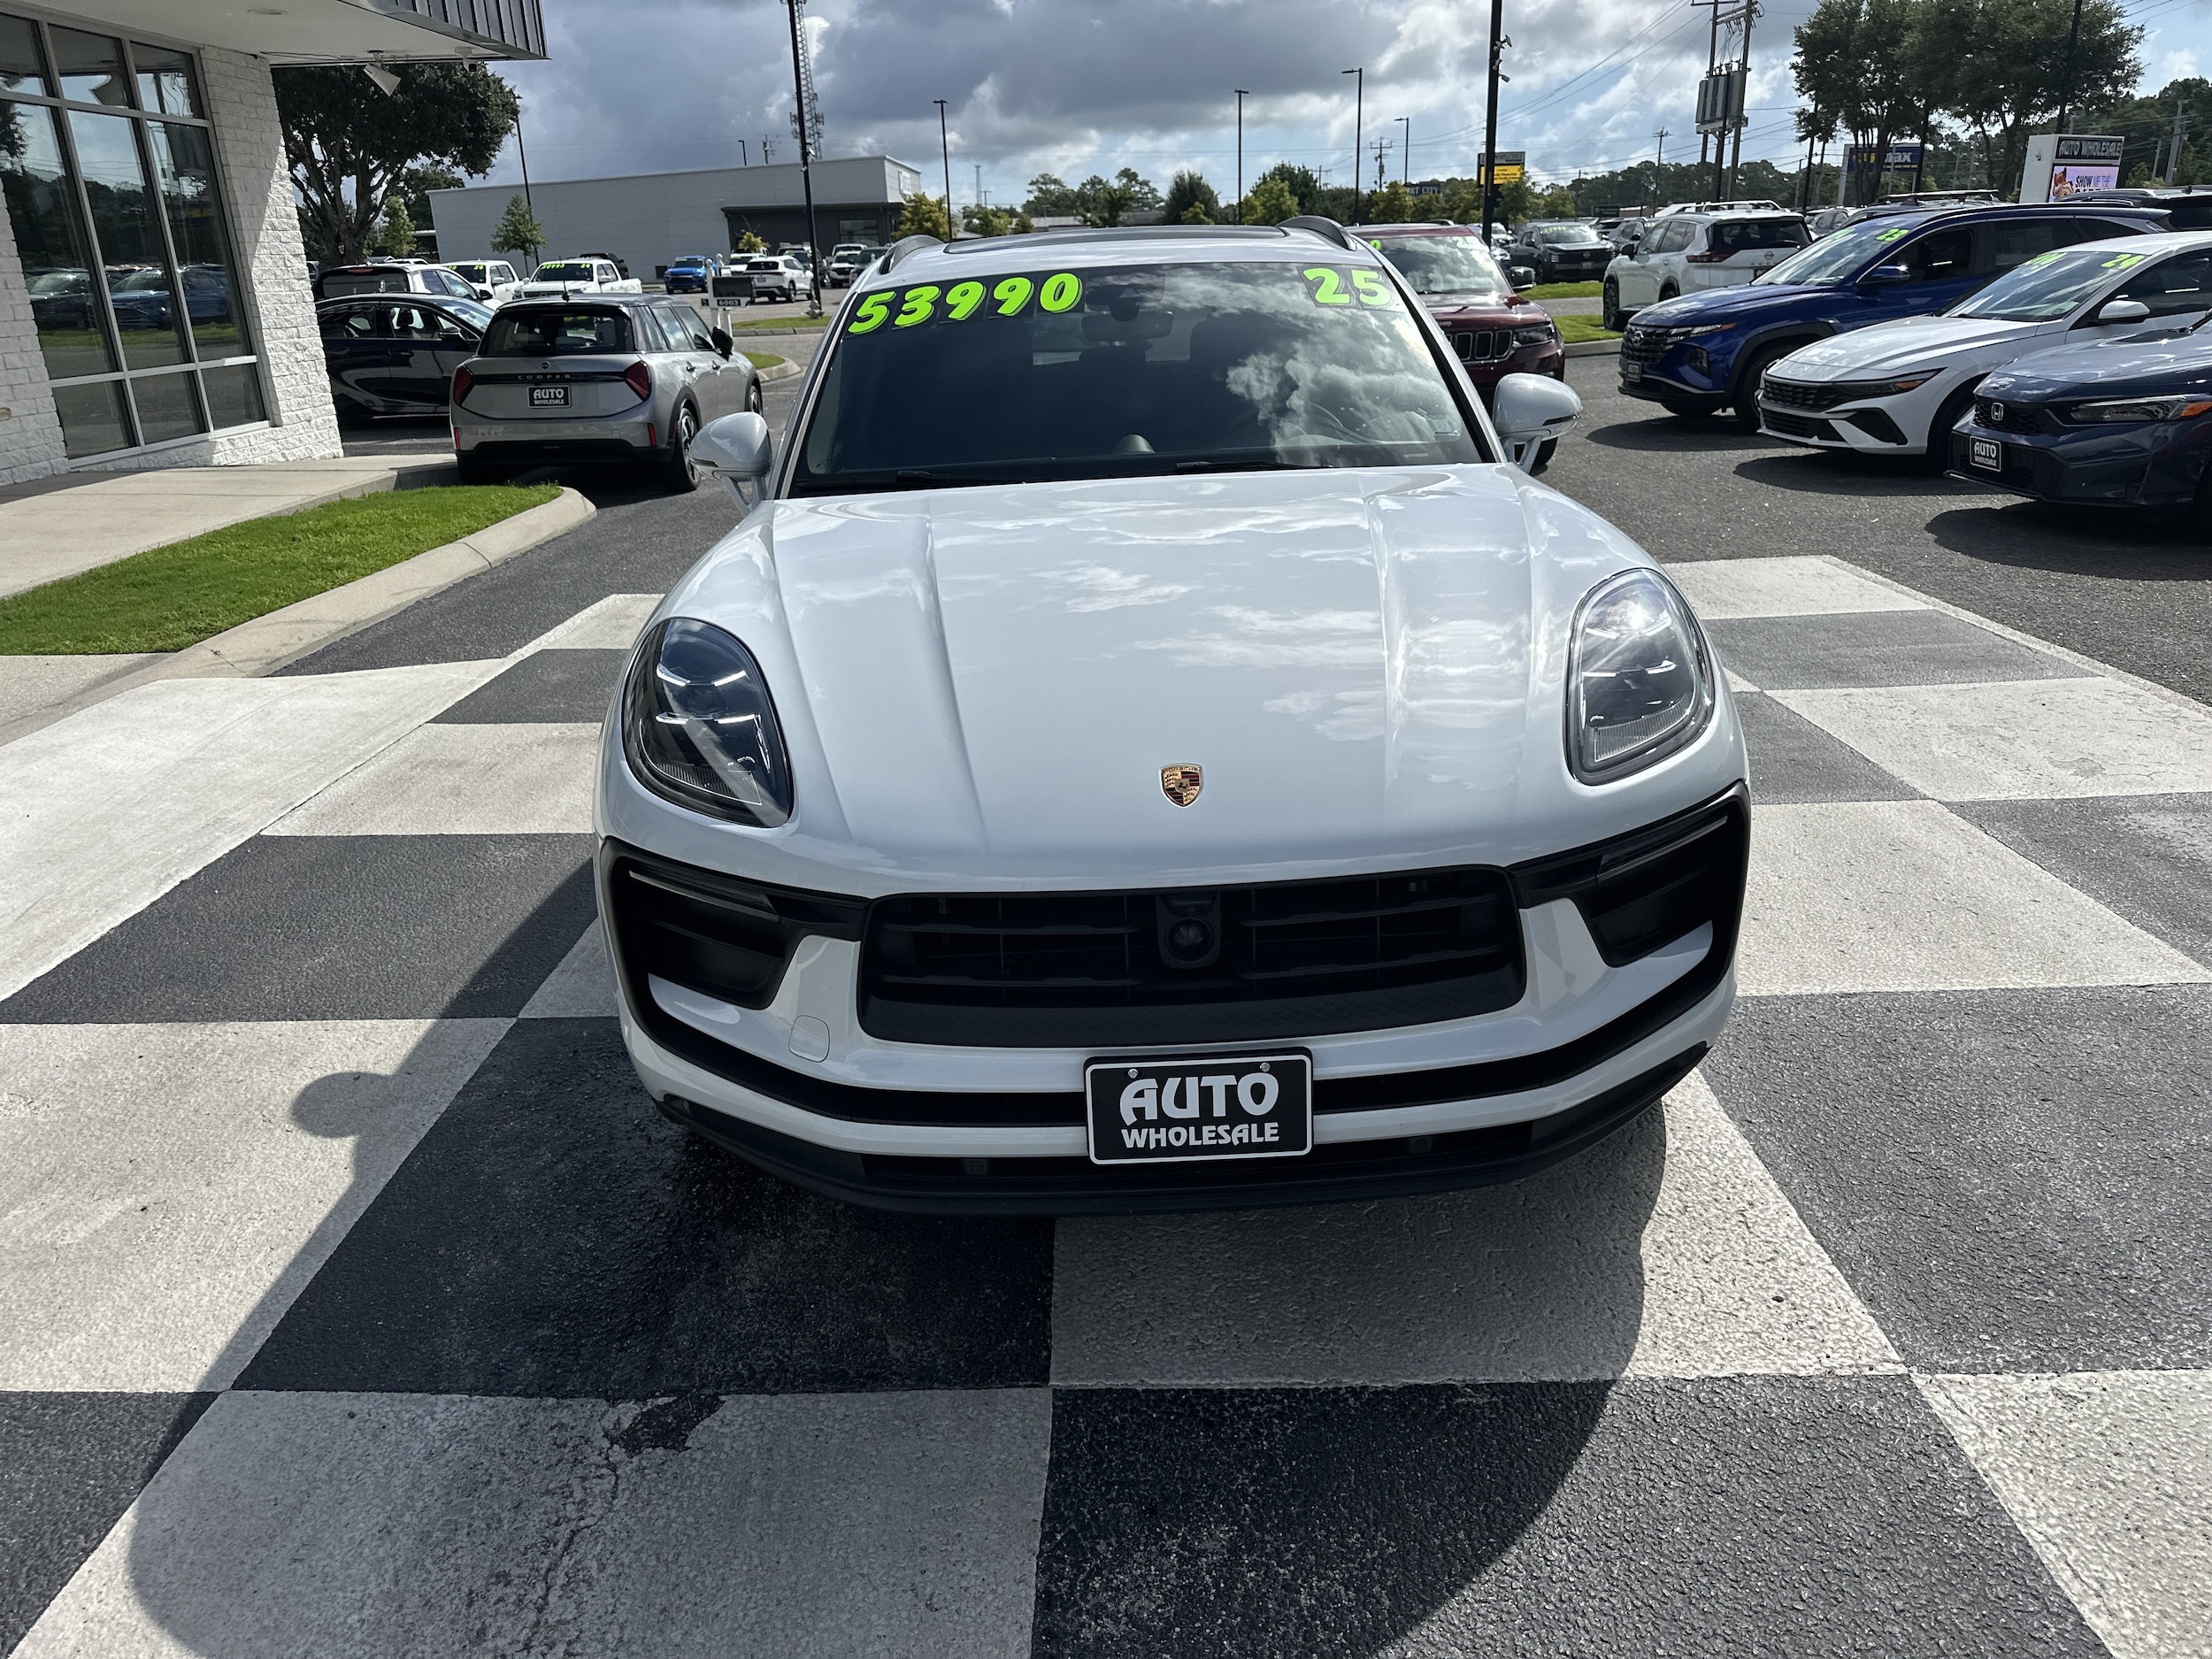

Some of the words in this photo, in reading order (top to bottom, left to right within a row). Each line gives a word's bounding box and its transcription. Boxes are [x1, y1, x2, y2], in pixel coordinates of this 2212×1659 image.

[2059, 140, 2080, 157] AUTO
[2081, 141, 2121, 157] WHOLESALE
[2076, 175, 2093, 188] SHOW
[1303, 267, 1394, 306] 25
[847, 273, 1083, 335] 53990
[534, 388, 565, 399] AUTO
[1974, 442, 1997, 458] AUTO
[1119, 1071, 1279, 1126] AUTO
[1120, 1121, 1280, 1150] WHOLESALE
